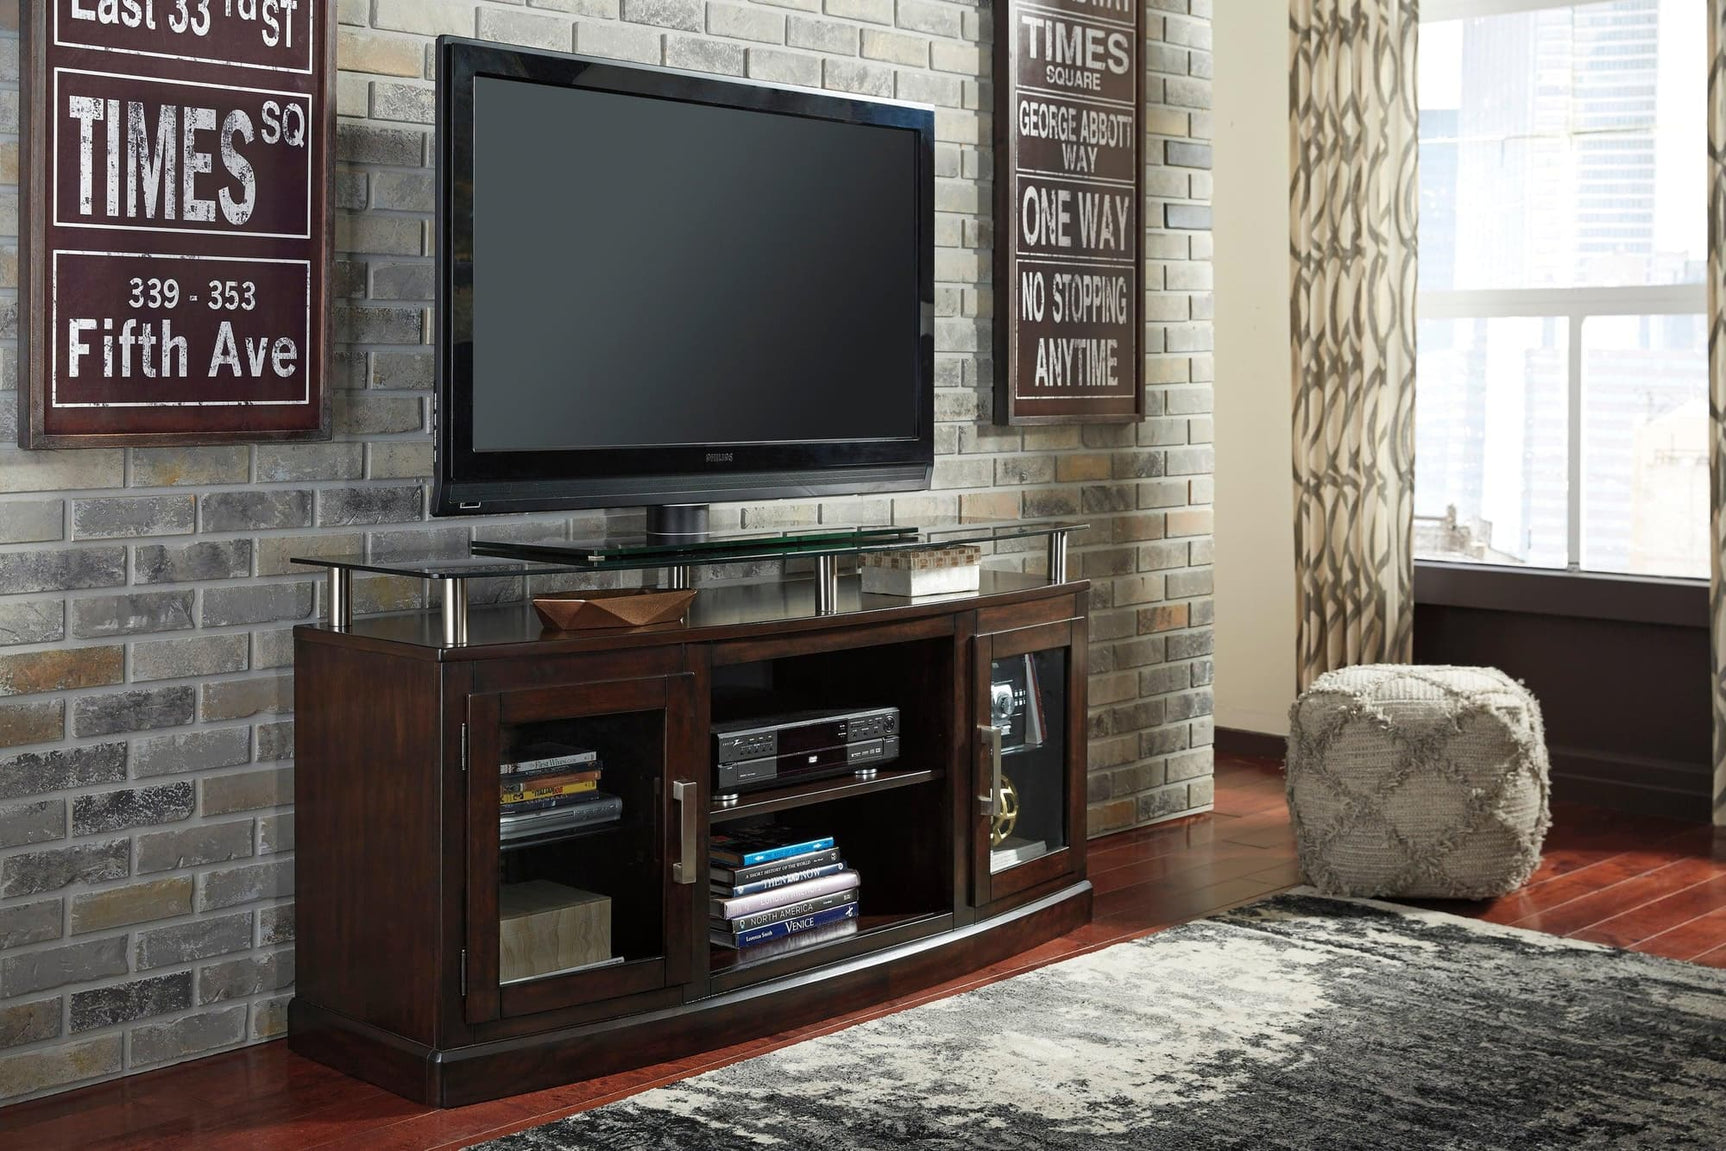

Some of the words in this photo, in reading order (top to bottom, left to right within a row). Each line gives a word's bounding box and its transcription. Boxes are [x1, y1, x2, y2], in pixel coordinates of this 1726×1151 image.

[1021, 15, 1129, 75] TIMES
[1046, 65, 1101, 90] SQUARE
[1019, 100, 1077, 142] GEORGE
[1080, 110, 1133, 148] ABBOTT
[69, 95, 256, 225] TIMES
[261, 100, 305, 148] SQ
[1061, 143, 1098, 173] WAY
[1022, 185, 1071, 247] ONE
[1077, 191, 1130, 250] WAY
[128, 277, 180, 309] 339
[207, 279, 256, 311] 353
[1022, 271, 1045, 323] NO
[1052, 272, 1127, 325] STOPPING
[68, 318, 188, 378] Fifth
[207, 321, 298, 378] Ave
[1034, 337, 1119, 387] ANYTIME
[705, 452, 734, 462] PHILIPS
[800, 867, 821, 880] NOW
[750, 913, 778, 926] NORTH
[779, 903, 814, 920] AMERICA
[785, 917, 815, 933] VENICE
